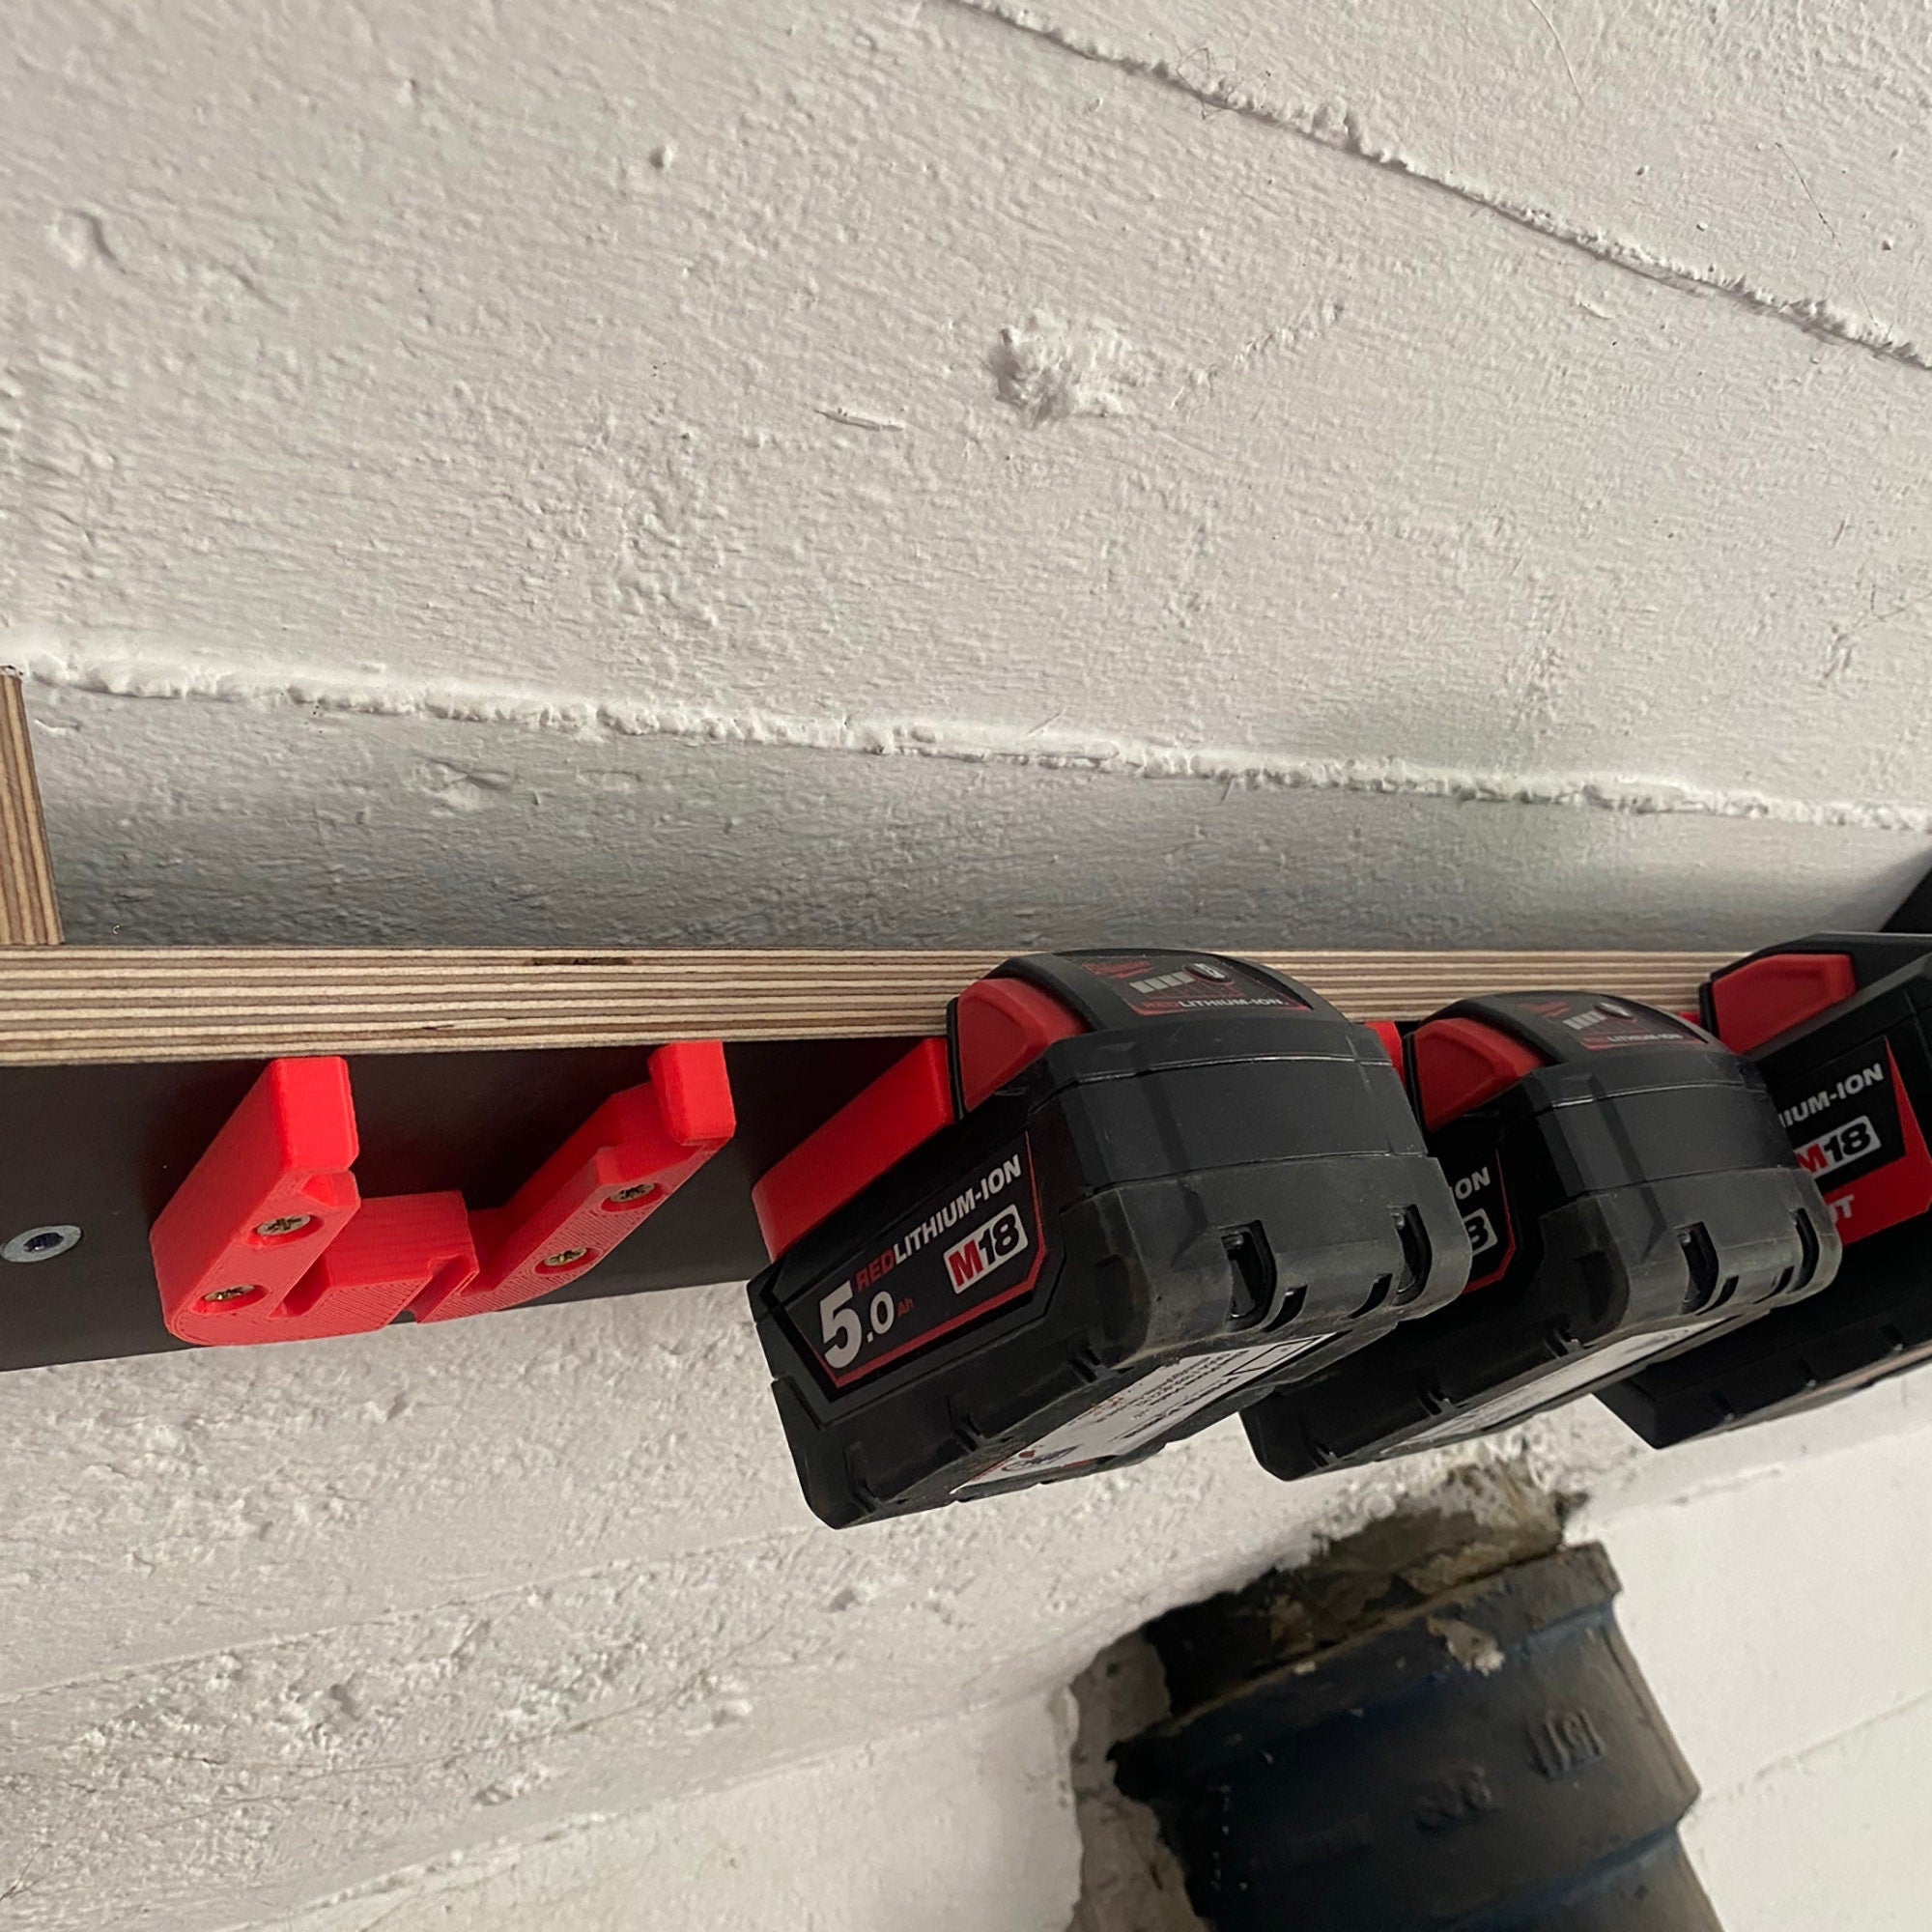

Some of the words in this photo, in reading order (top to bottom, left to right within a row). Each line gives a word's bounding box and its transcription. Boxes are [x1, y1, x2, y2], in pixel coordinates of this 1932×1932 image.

[1796, 1122, 1872, 1173] M18
[855, 1154, 1022, 1293] REDLITHIUM-ION
[949, 1213, 1020, 1289] M18
[820, 1280, 895, 1370] 5.0
